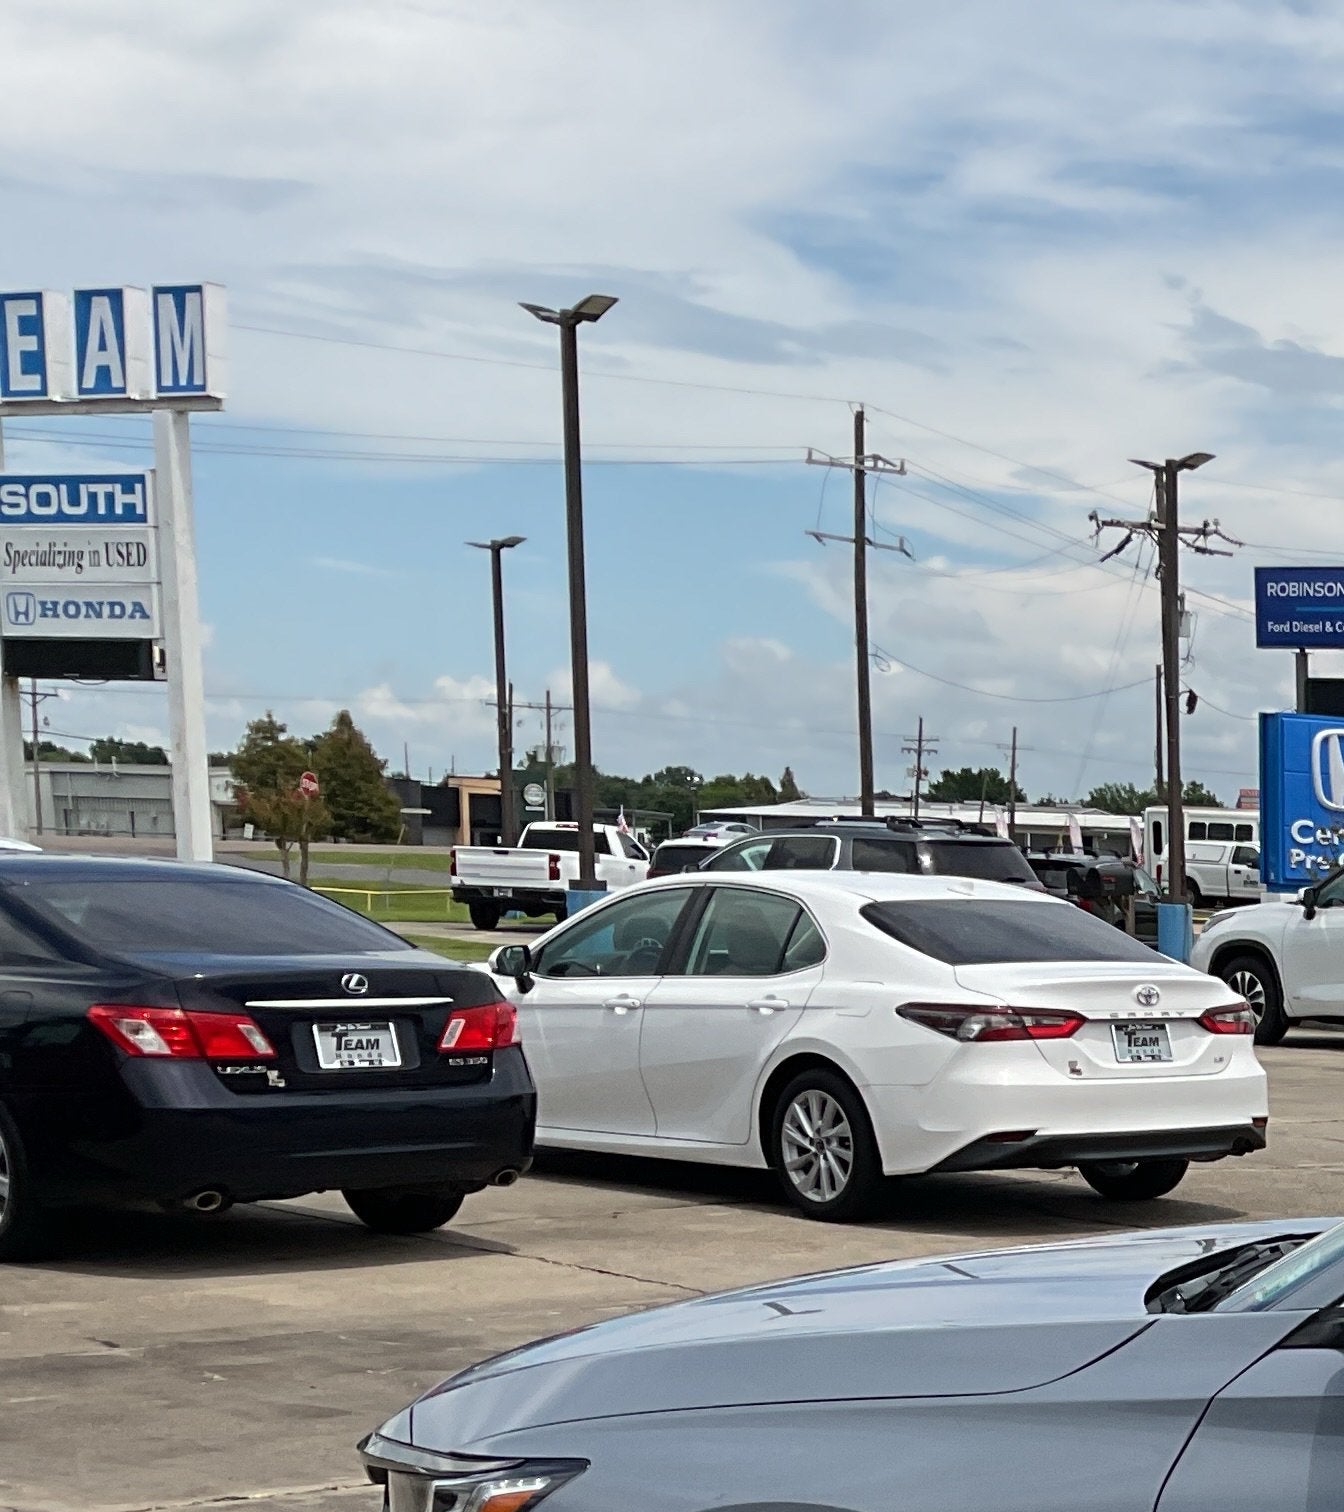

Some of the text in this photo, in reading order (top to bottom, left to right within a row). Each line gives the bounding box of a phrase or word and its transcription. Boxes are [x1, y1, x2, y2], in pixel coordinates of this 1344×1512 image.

[0, 483, 144, 515] SOUTH
[4, 540, 147, 574] Specializing in USED
[39, 600, 150, 619] HONDA
[1268, 621, 1290, 632] Ford
[1293, 621, 1322, 632] Diesel
[1325, 621, 1333, 632] &
